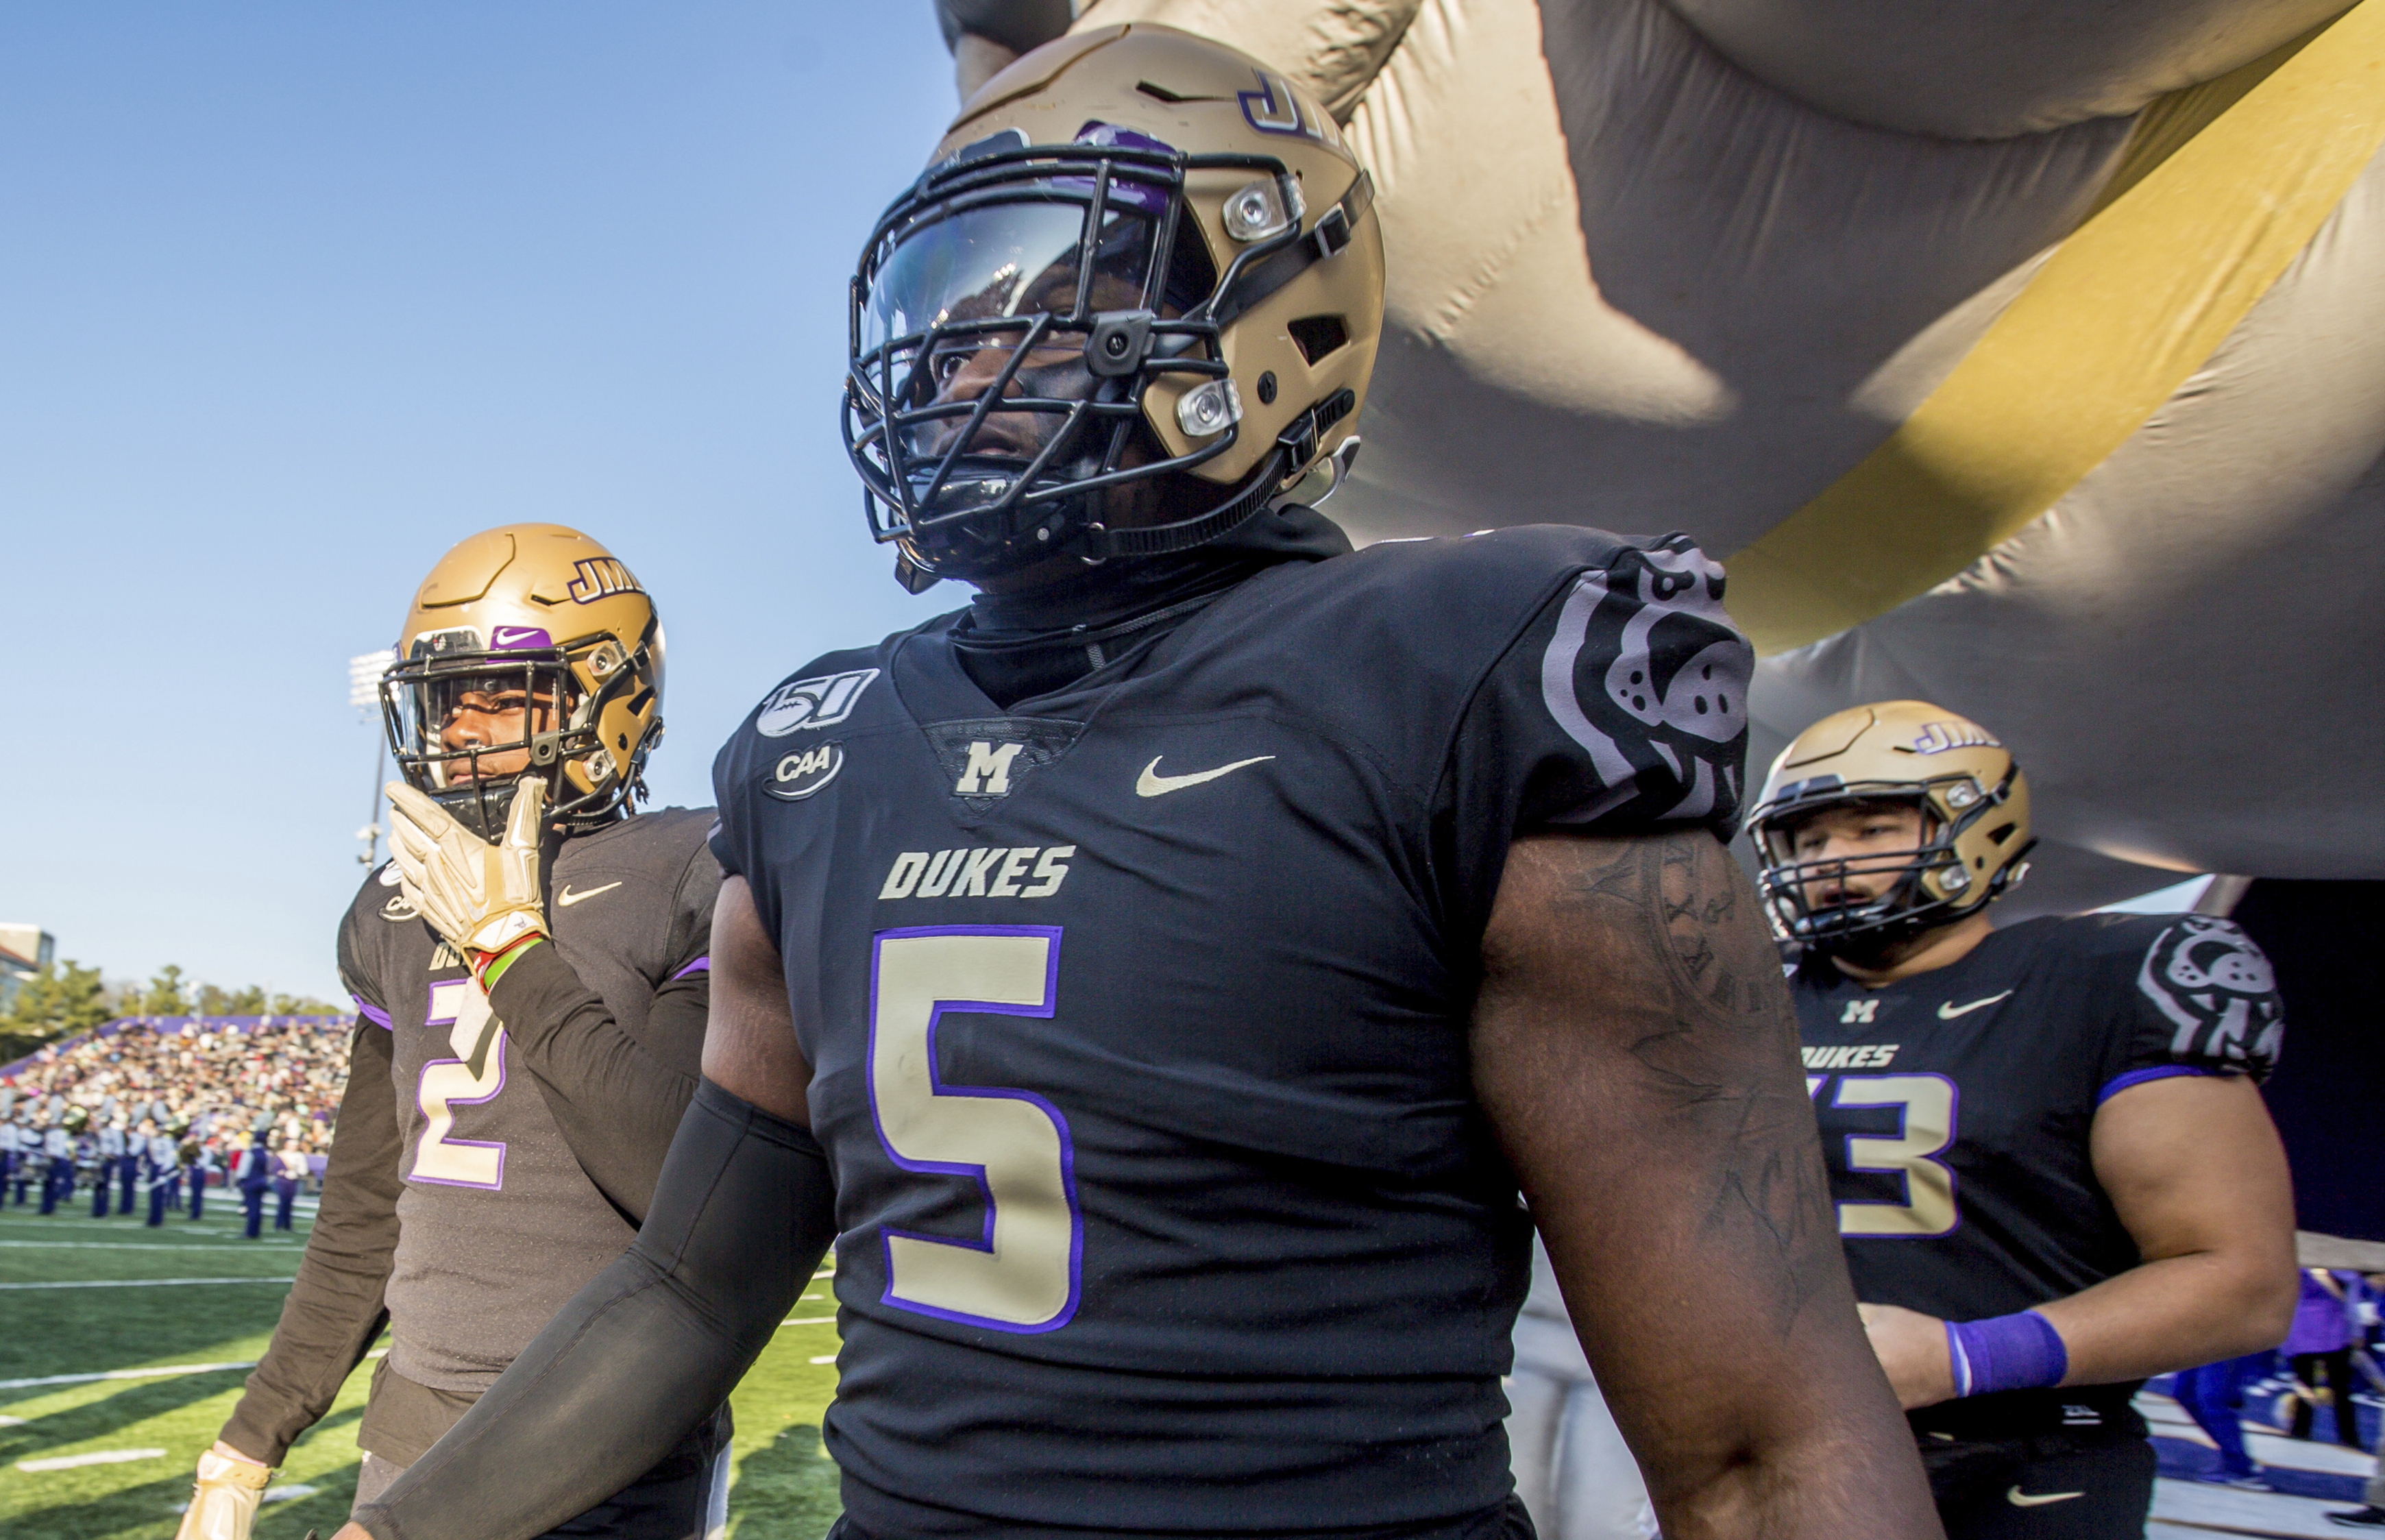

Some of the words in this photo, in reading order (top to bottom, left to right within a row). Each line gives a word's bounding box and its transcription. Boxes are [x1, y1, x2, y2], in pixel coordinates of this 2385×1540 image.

[776, 746, 831, 782] CAA
[957, 742, 1023, 792] M
[878, 845, 1076, 900] DUKES
[1839, 999, 1880, 1023] M
[408, 979, 507, 1191] 2
[866, 925, 1084, 1334] 5
[1805, 1072, 1962, 1239] 3
